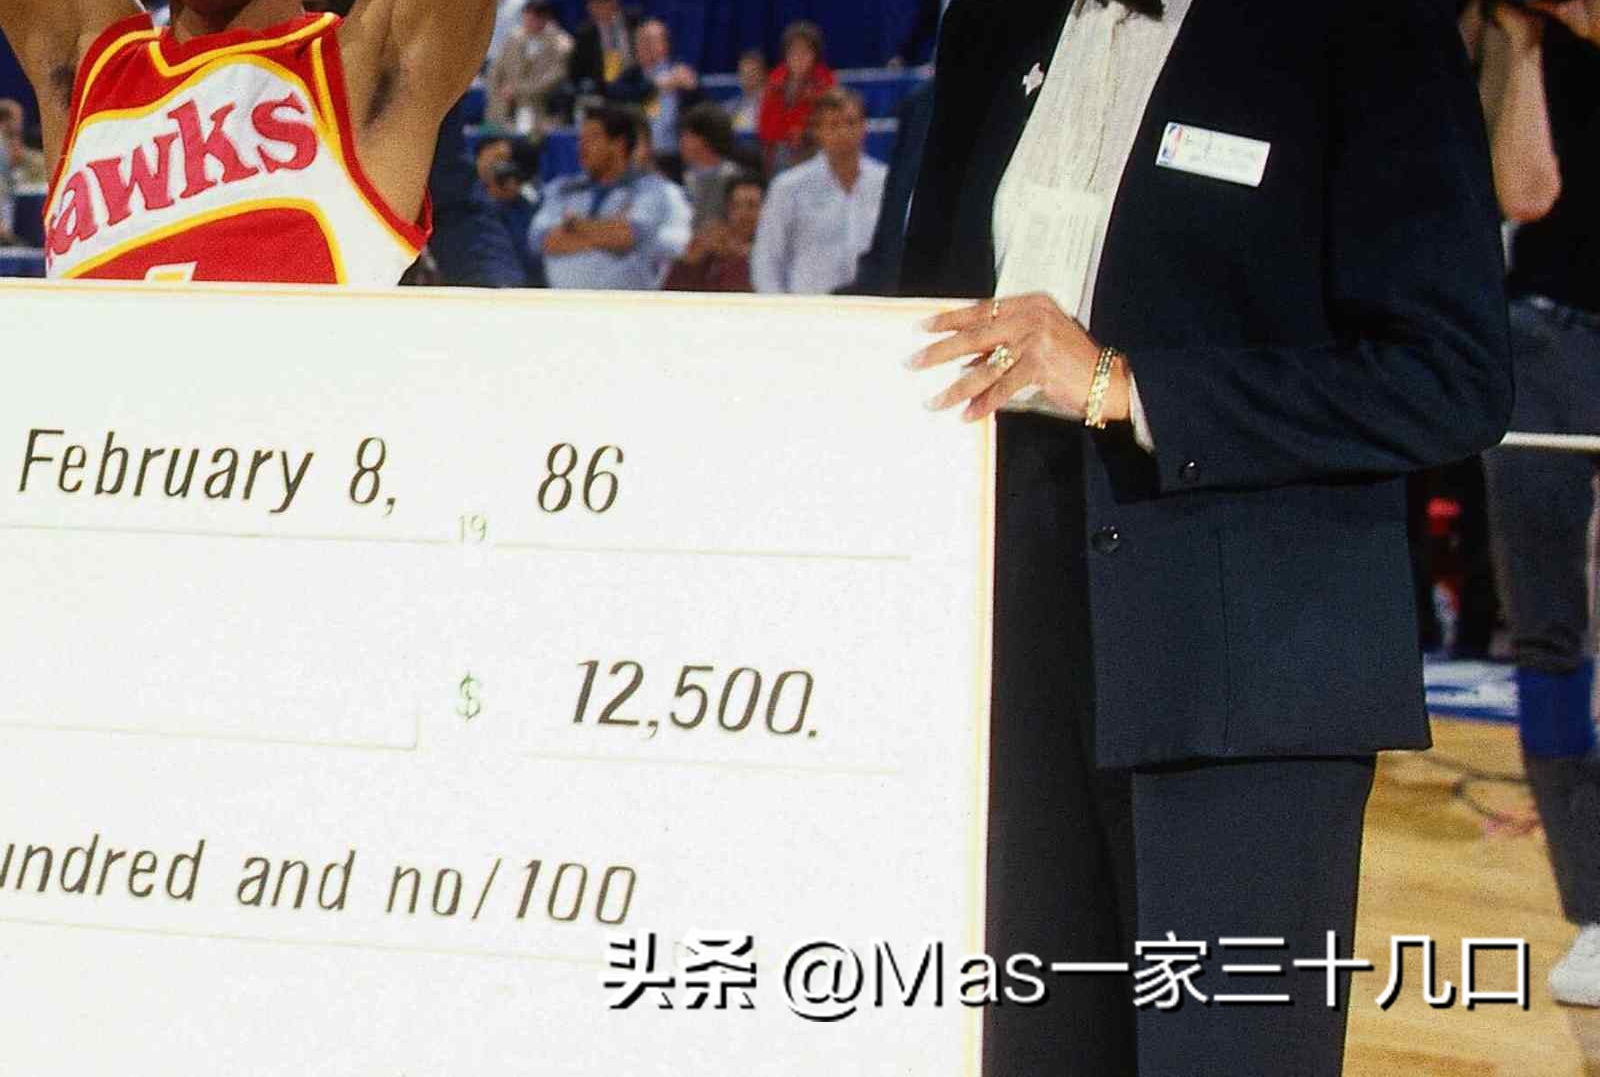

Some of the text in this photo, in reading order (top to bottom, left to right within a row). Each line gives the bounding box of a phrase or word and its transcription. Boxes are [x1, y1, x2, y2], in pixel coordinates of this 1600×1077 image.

[46, 91, 317, 261] awks
[19, 429, 623, 542] February 8, 19 86
[457, 672, 483, 722] $
[237, 850, 357, 911] and
[386, 859, 636, 925] no/100
